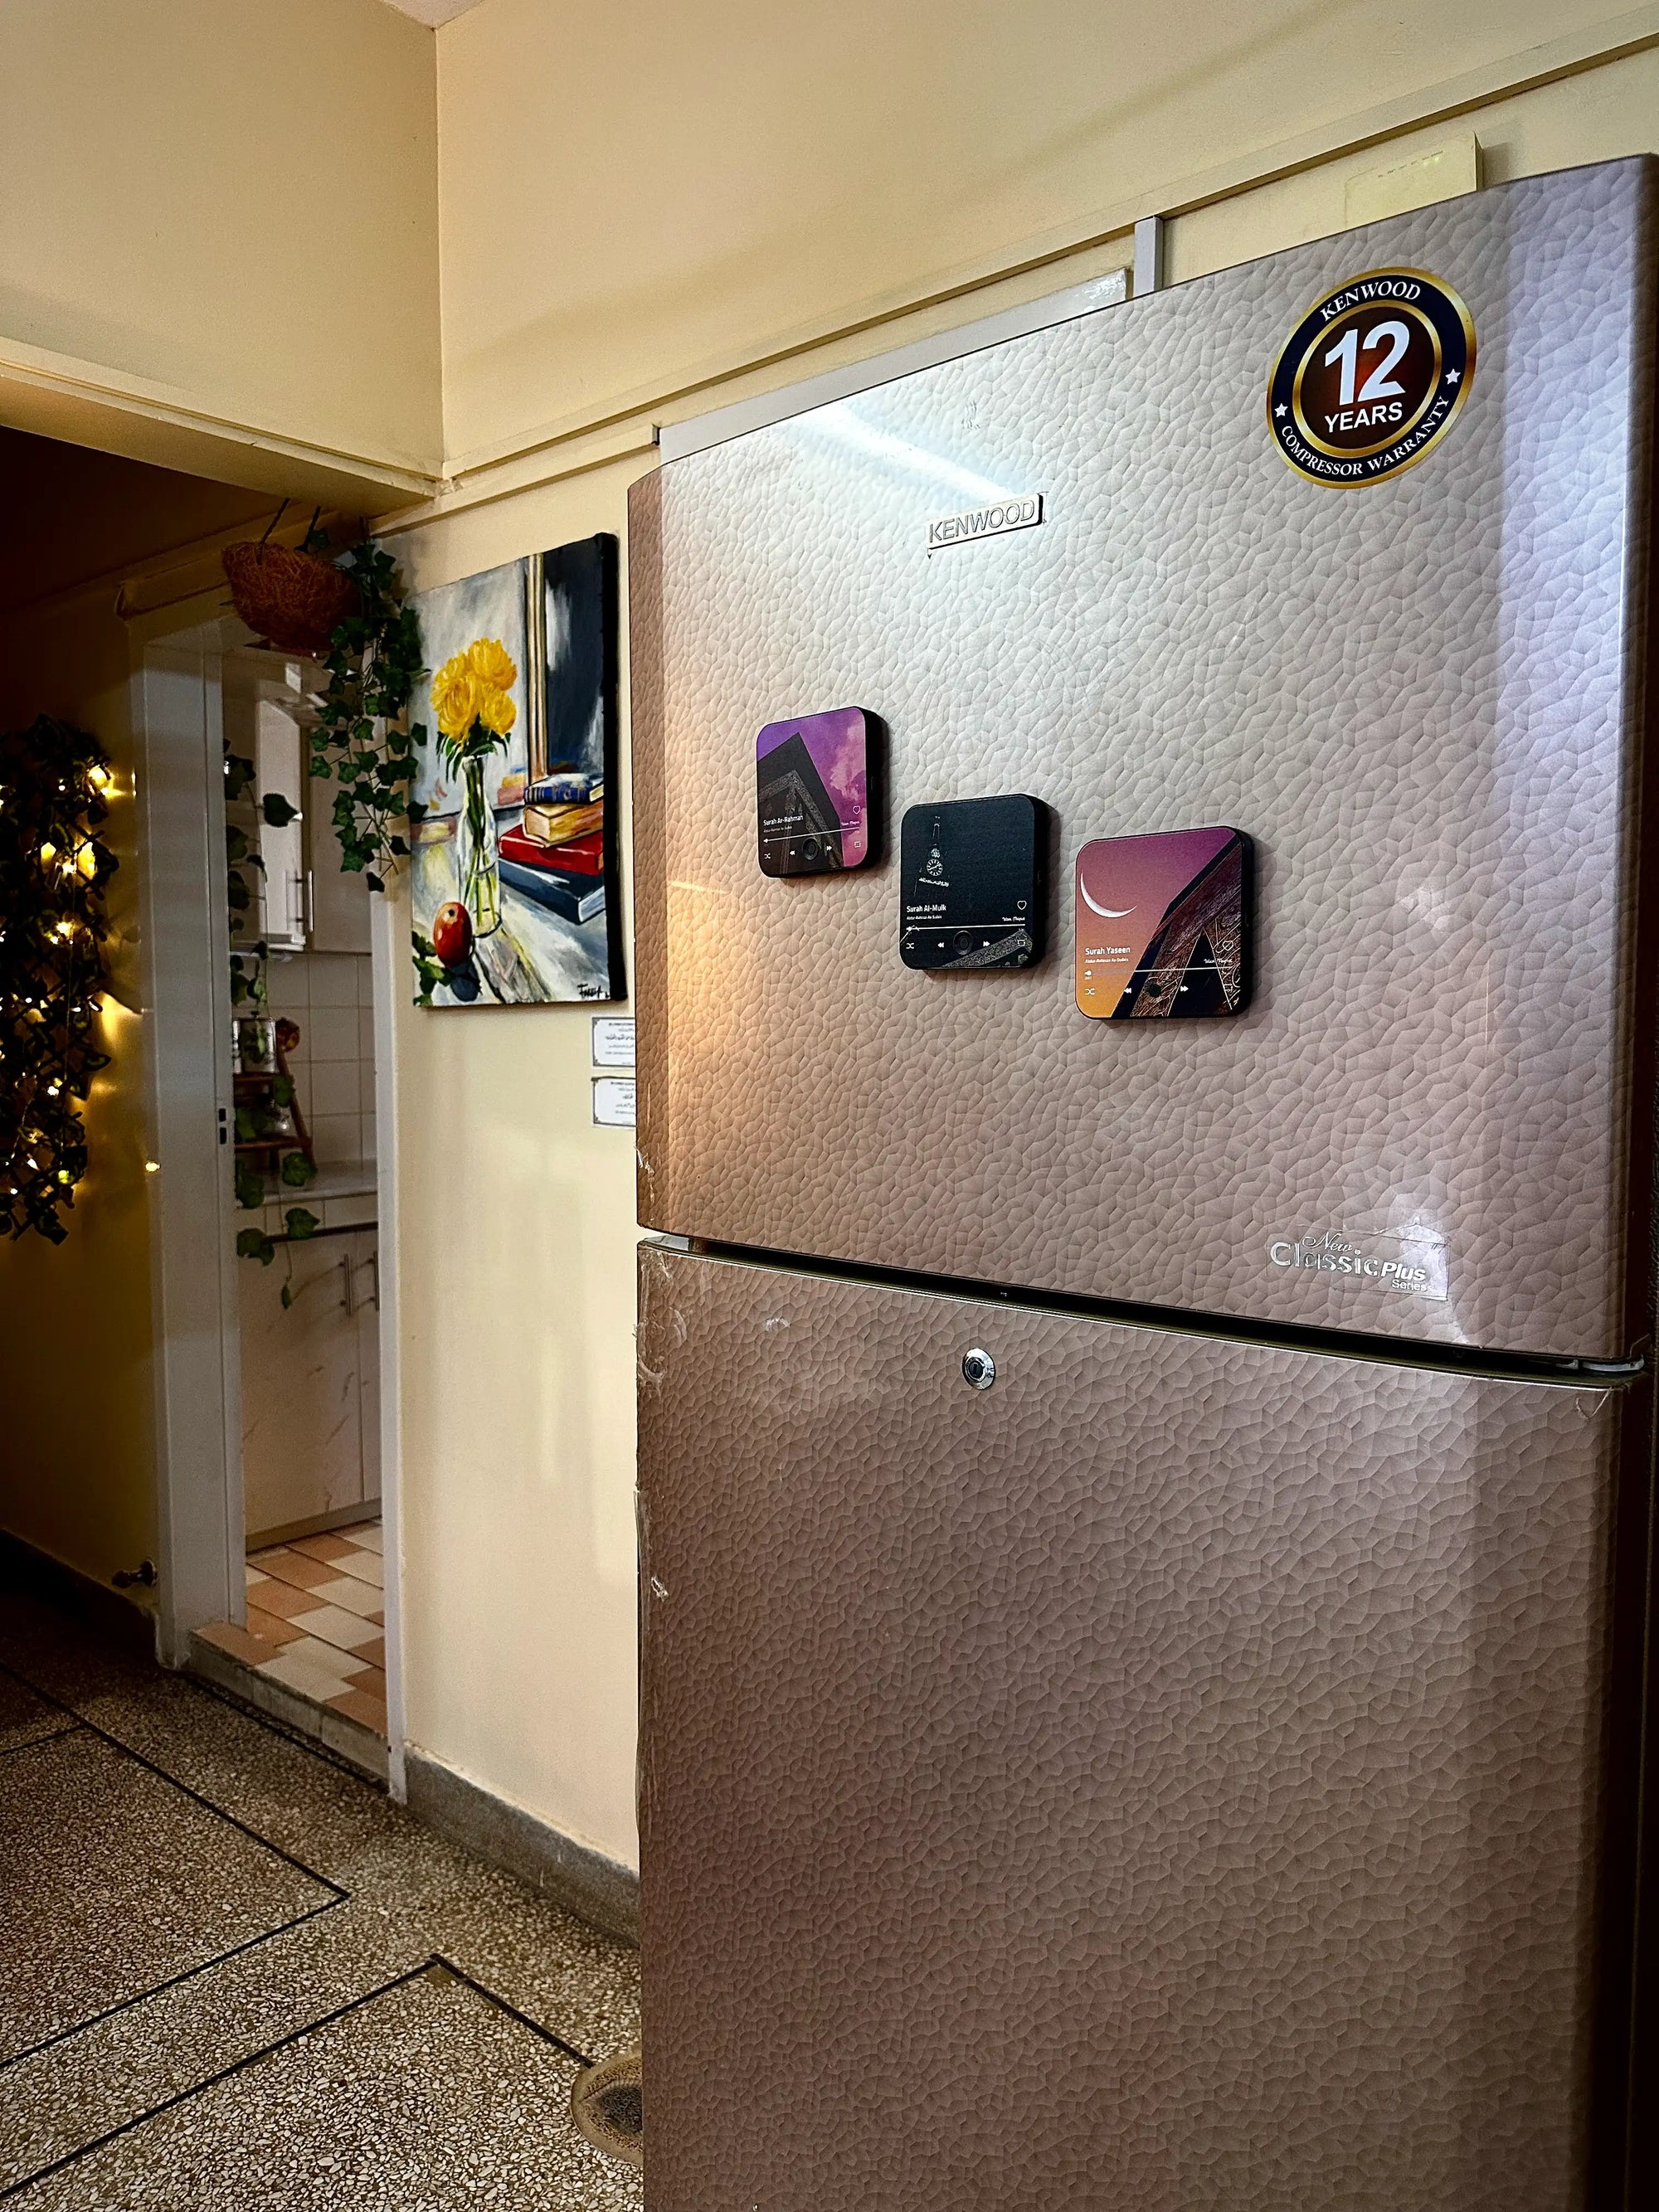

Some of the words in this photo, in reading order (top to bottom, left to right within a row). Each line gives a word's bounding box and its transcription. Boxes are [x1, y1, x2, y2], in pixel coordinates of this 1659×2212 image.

[1320, 280, 1421, 322] KENWOOD
[1325, 320, 1410, 406] 12
[1282, 425, 1363, 476] COMPRESSOR
[1366, 395, 1449, 472] WARRANTY
[1325, 401, 1403, 434] YEARS
[929, 499, 1035, 543] KENWOOD
[1270, 1242, 1379, 1276] Classic
[1380, 1261, 1427, 1281] Plus
[1302, 1231, 1353, 1253] New
[1391, 1279, 1428, 1292] Series
